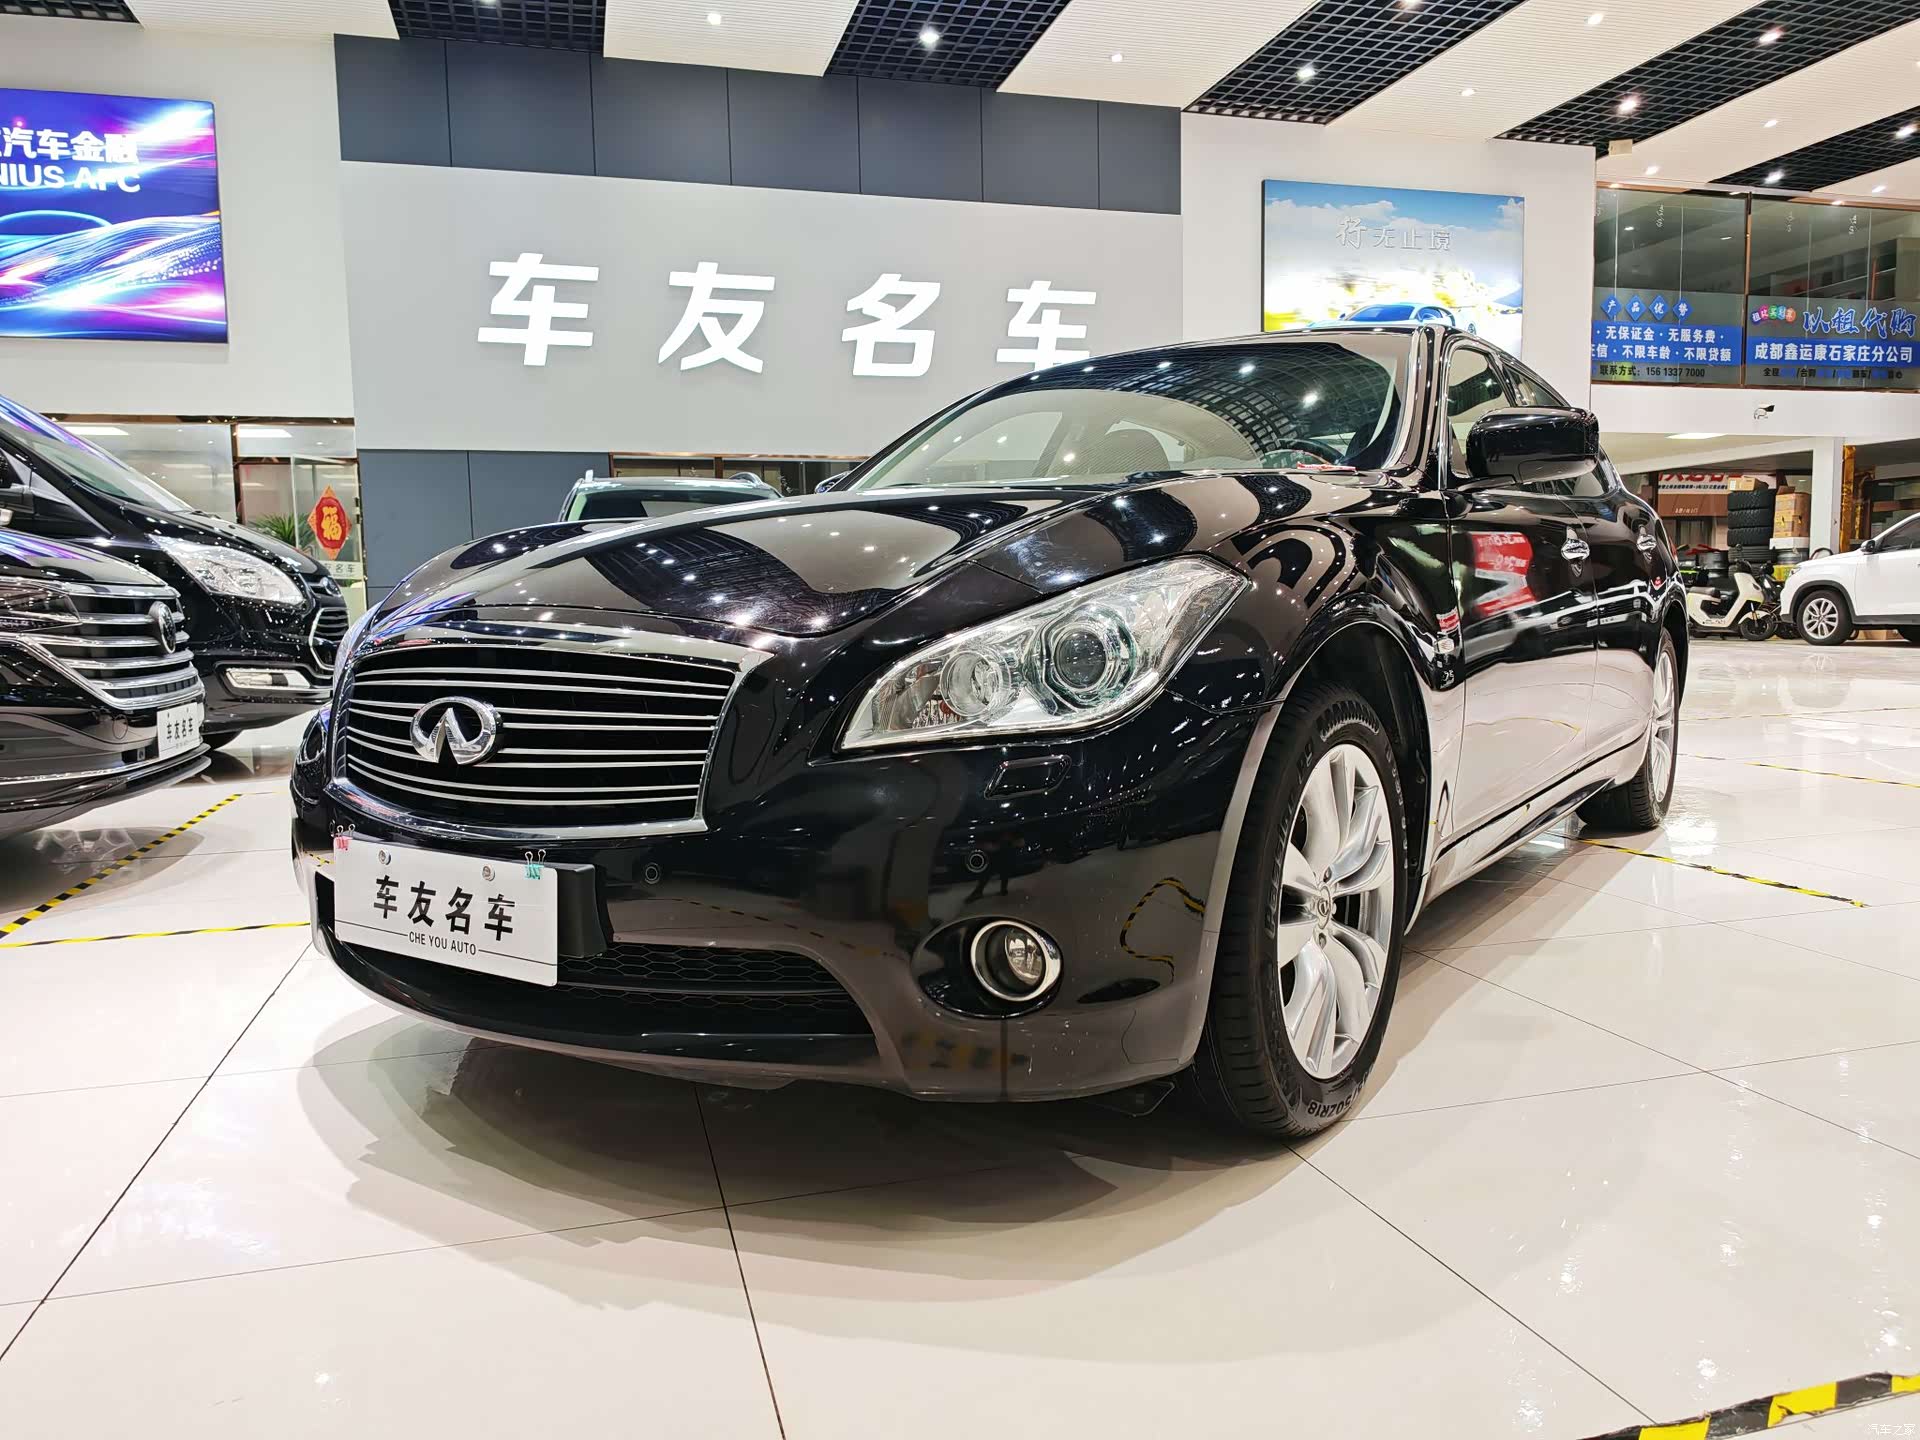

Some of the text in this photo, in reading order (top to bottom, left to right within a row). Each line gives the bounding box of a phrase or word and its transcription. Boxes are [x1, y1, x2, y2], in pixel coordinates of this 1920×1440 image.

[0, 127, 139, 164] 汽车金融
[478, 252, 1096, 377] 车友名车
[1607, 300, 1689, 317] 产品优势
[1803, 306, 1917, 339] 以租代购
[1754, 342, 1912, 363] 成都鑫运康石家庄分公司
[321, 506, 343, 541] 福
[373, 875, 516, 942] 车友名车
[409, 931, 477, 956] CHE YOU AUTO
